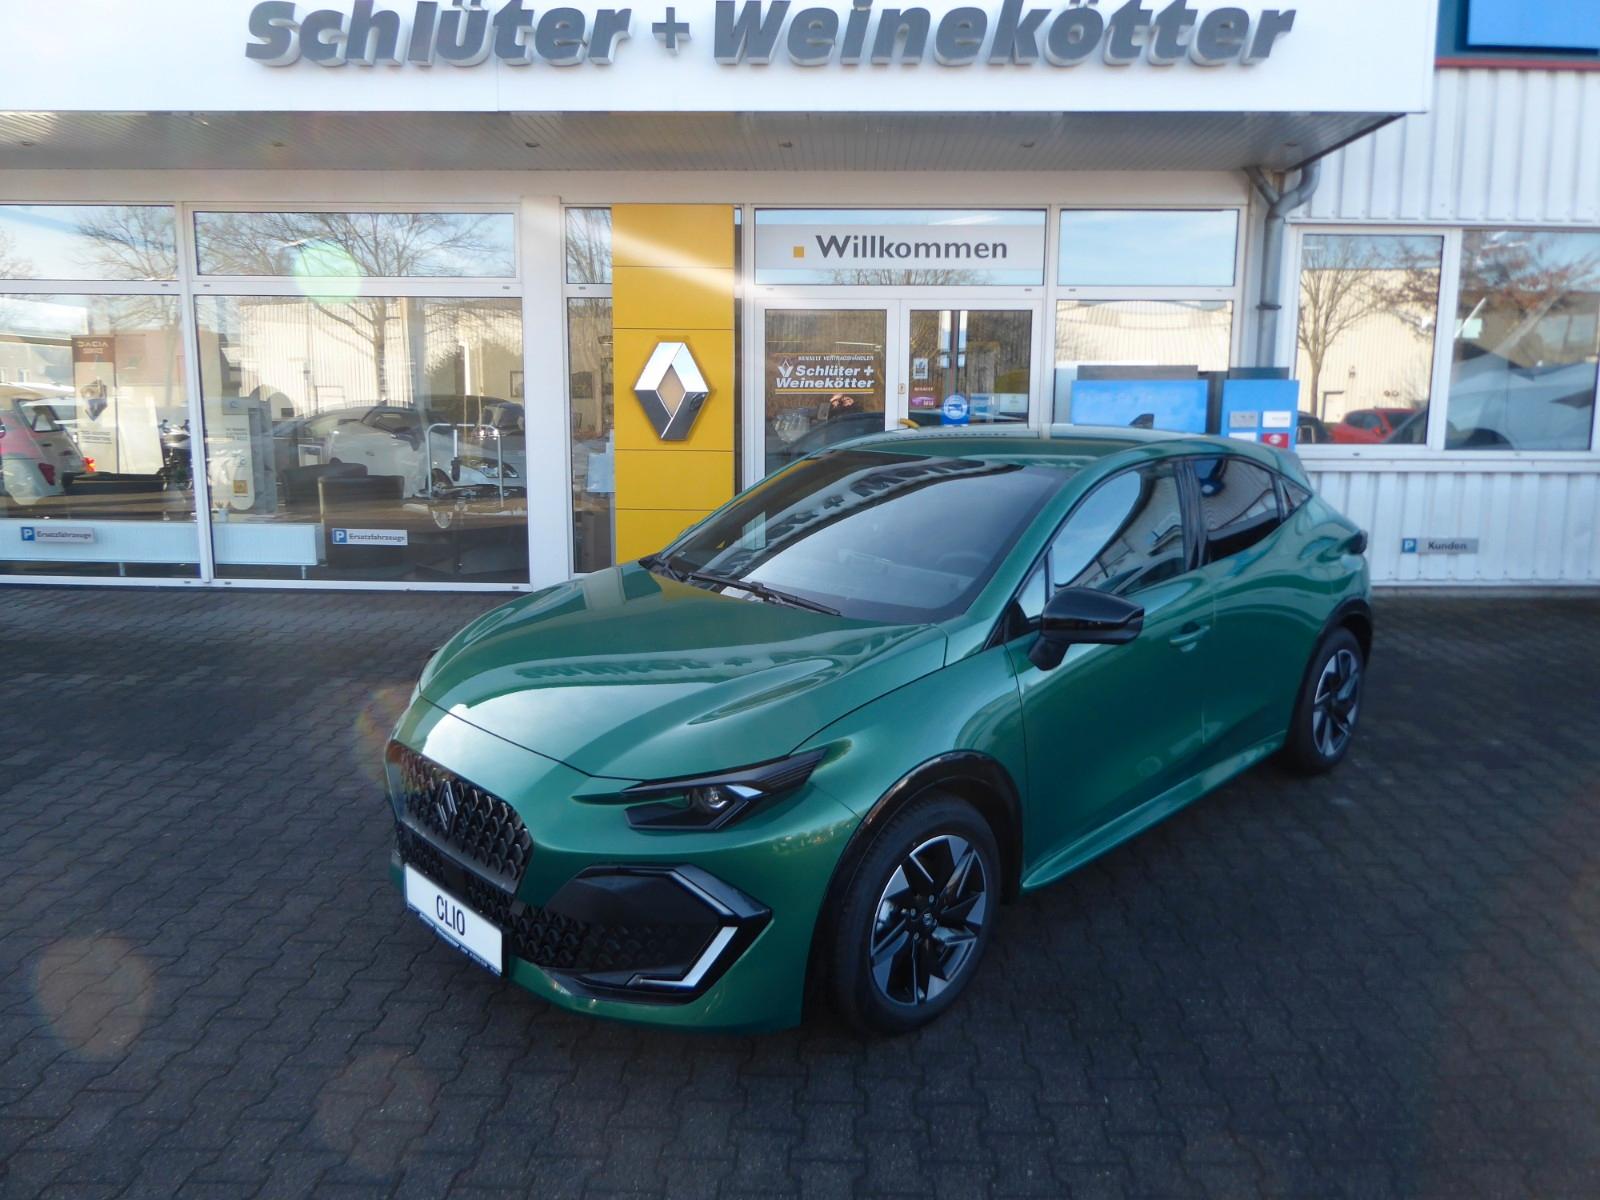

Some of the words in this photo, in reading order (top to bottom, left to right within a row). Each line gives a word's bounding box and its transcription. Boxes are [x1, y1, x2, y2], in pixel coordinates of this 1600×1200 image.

[245, 0, 633, 66] Schlüter
[652, 6, 692, 56] +
[714, 0, 1297, 66] Weinekötter
[815, 235, 1008, 259] Willkommen
[795, 365, 861, 376] Schlüter
[863, 365, 874, 376] +
[776, 377, 875, 388] Weinekötter
[335, 531, 345, 542] P
[1404, 541, 1414, 551] P
[1427, 541, 1468, 551] Kunden
[436, 894, 466, 936] CLIO
